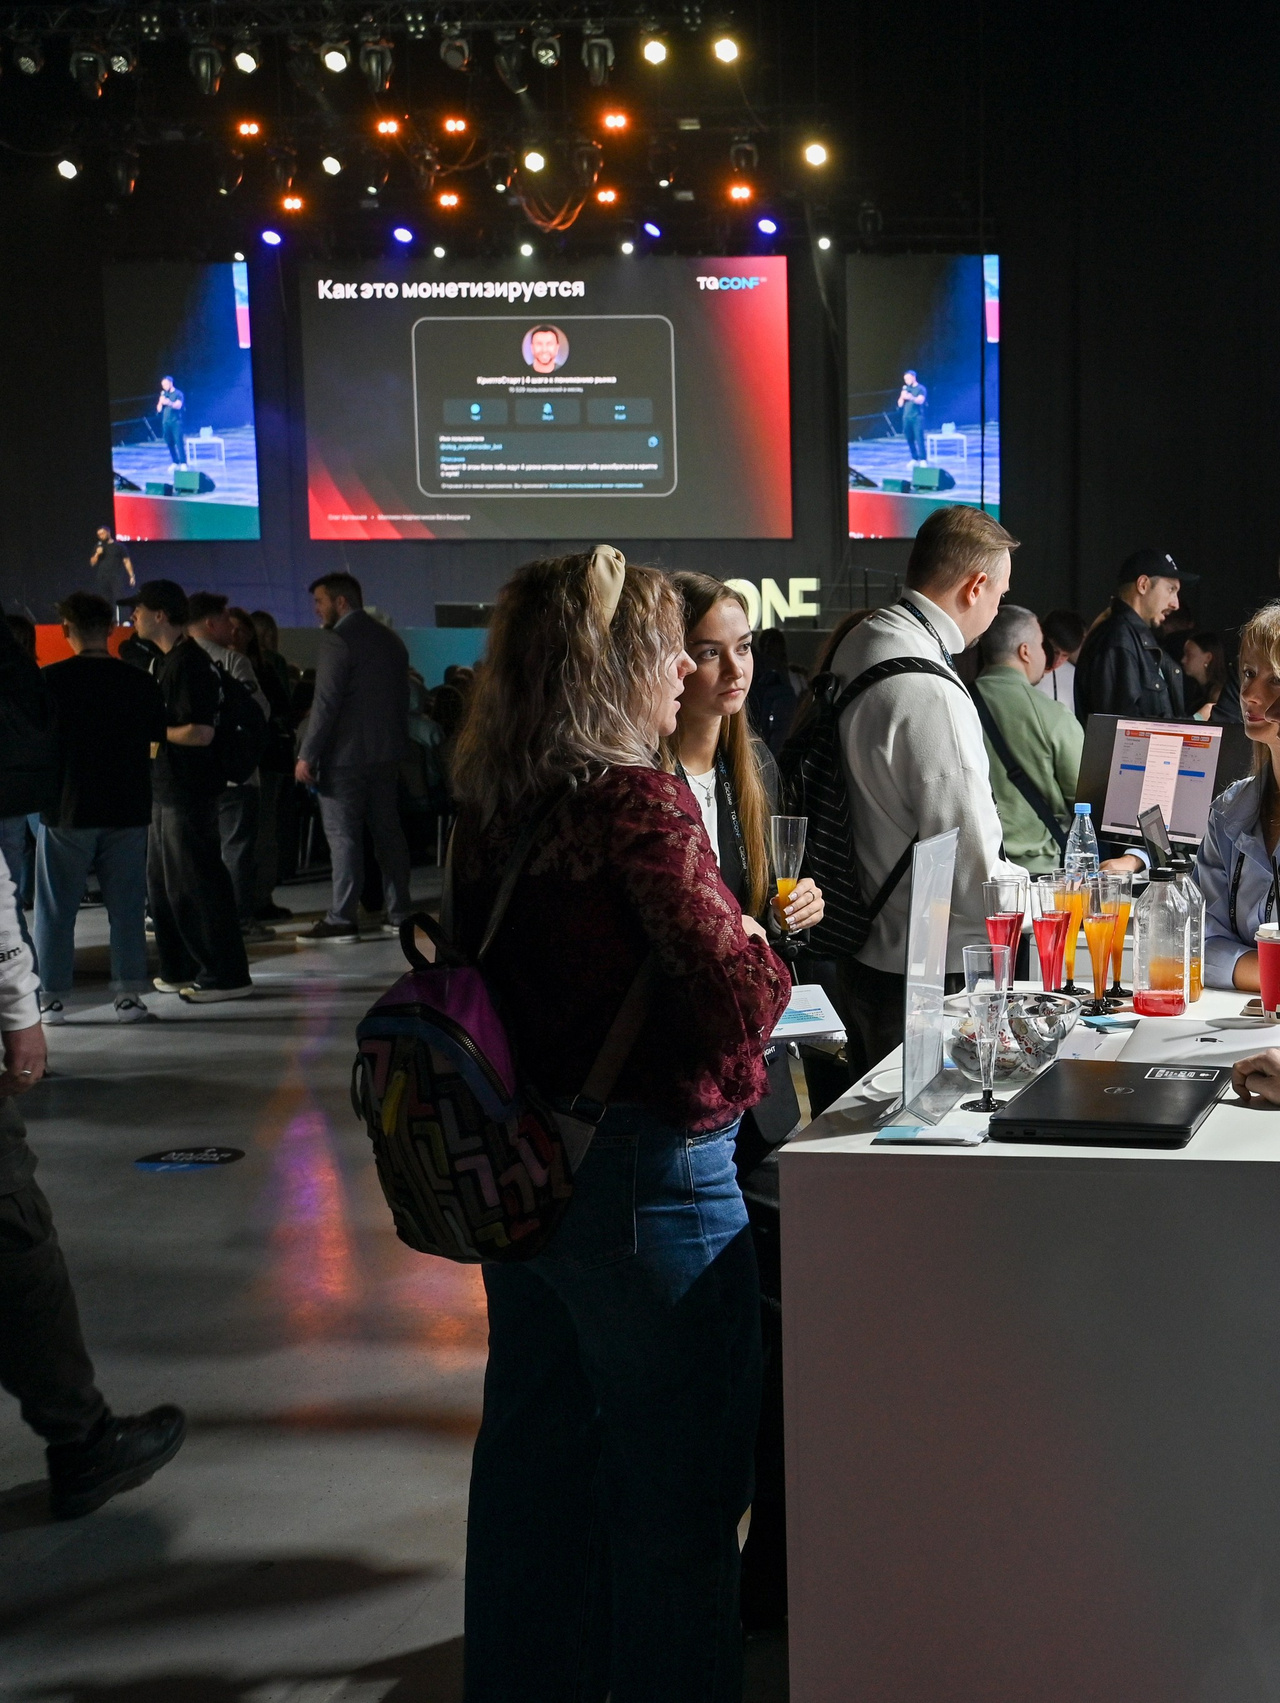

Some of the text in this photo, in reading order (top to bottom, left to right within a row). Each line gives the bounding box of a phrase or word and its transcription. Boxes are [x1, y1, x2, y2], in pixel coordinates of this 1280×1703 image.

[318, 279, 585, 303] Как это монетизируется
